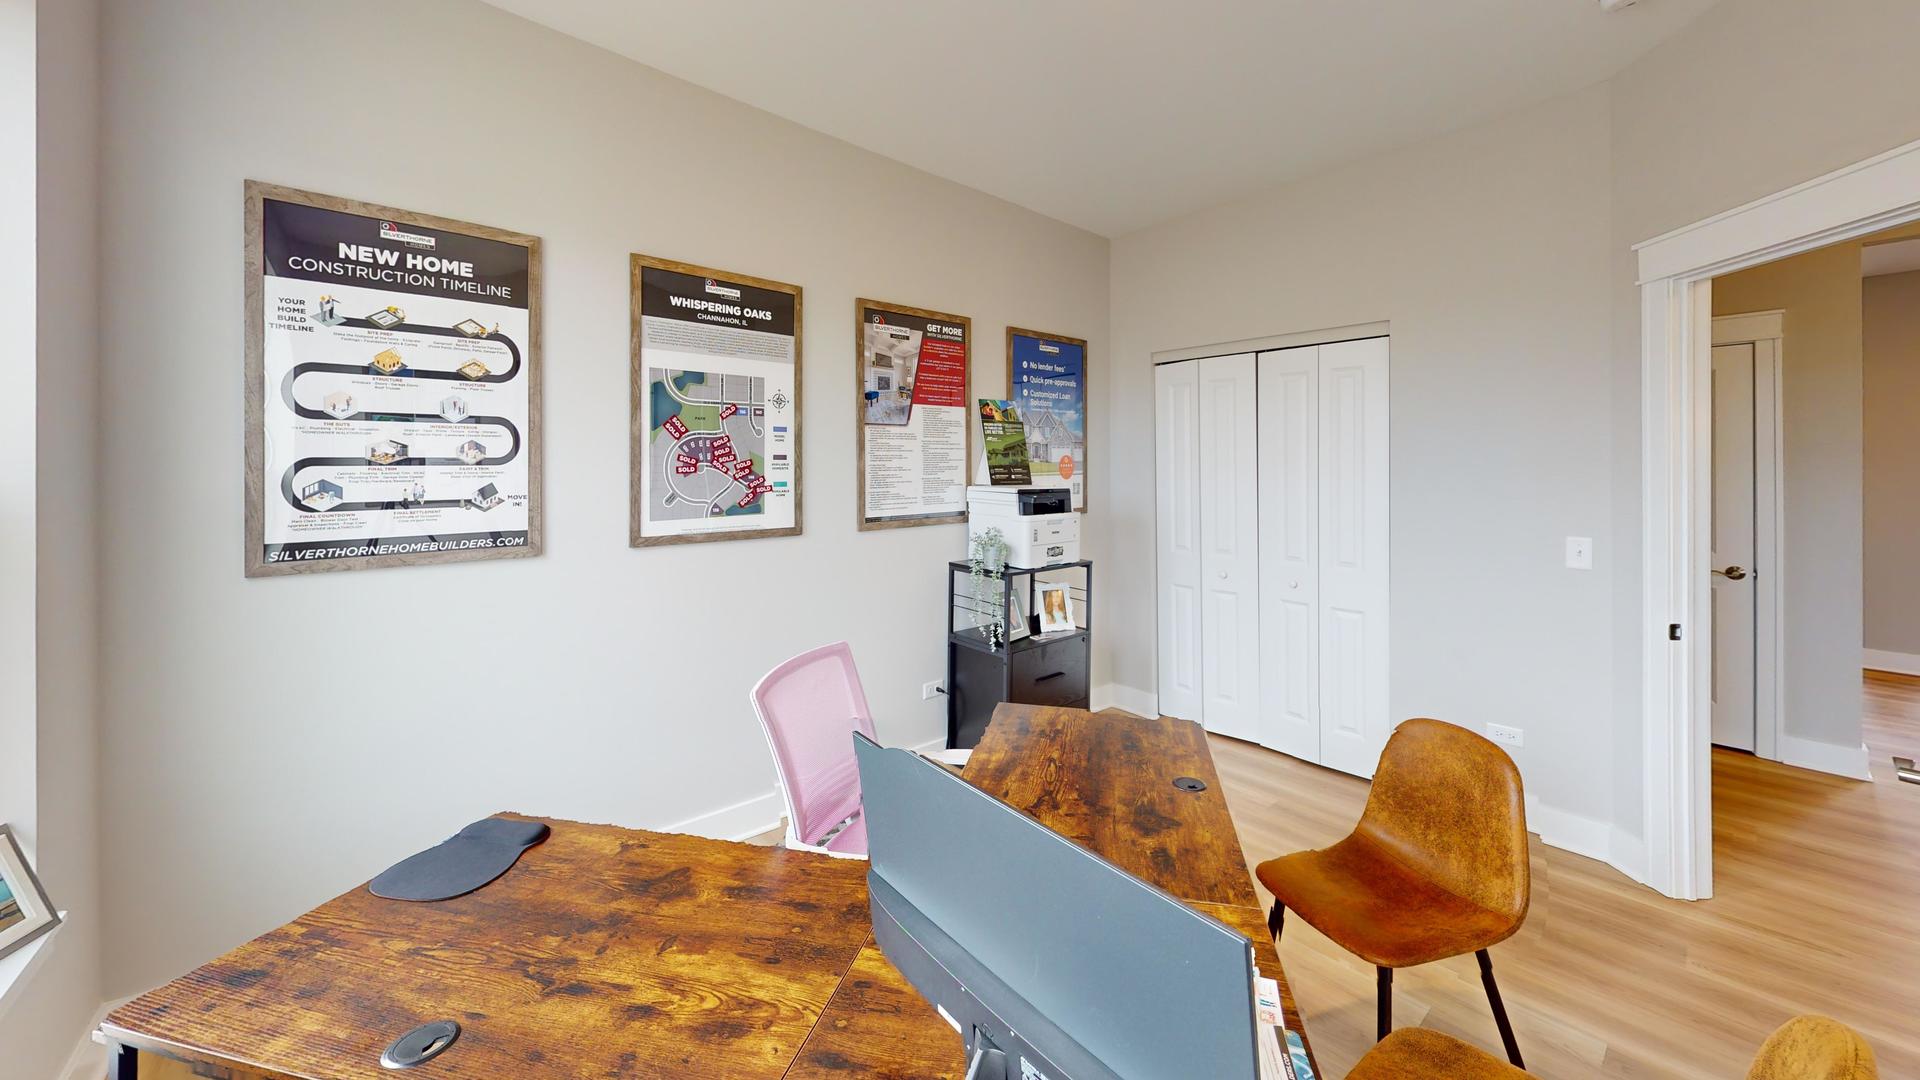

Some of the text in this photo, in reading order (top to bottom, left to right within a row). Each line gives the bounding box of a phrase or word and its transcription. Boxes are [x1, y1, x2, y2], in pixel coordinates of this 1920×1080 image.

[383, 232, 432, 243] SILVERTHORNE
[338, 242, 474, 278] NEW HOME
[288, 256, 512, 299] CONSTRUCTION TIMELINE
[278, 297, 305, 306] YOUR
[278, 306, 306, 314] HOME
[670, 295, 772, 321] WHISPERING OAKS
[278, 314, 306, 323] BUILD
[697, 313, 741, 326] CHANNAHON,
[269, 323, 314, 332] TIMELINE
[927, 324, 962, 336] GET MORE
[1038, 362, 1053, 371] lender
[1030, 376, 1077, 387] Quick pre-approvals
[1030, 390, 1058, 399] Customized
[721, 406, 736, 418] SOLD
[672, 417, 686, 432] SOLD
[665, 423, 680, 438] SOLD
[713, 437, 728, 447] SOLD
[714, 448, 730, 456] SOLD
[680, 456, 696, 464] SOLD
[736, 461, 751, 469] SOLD
[712, 460, 726, 472] SOLD
[735, 469, 749, 478] SOLD
[750, 477, 763, 488] SOLD
[740, 493, 753, 506] SOLD
[268, 537, 525, 562] SILVERTHORNEHOMEBUILDERS.COM
